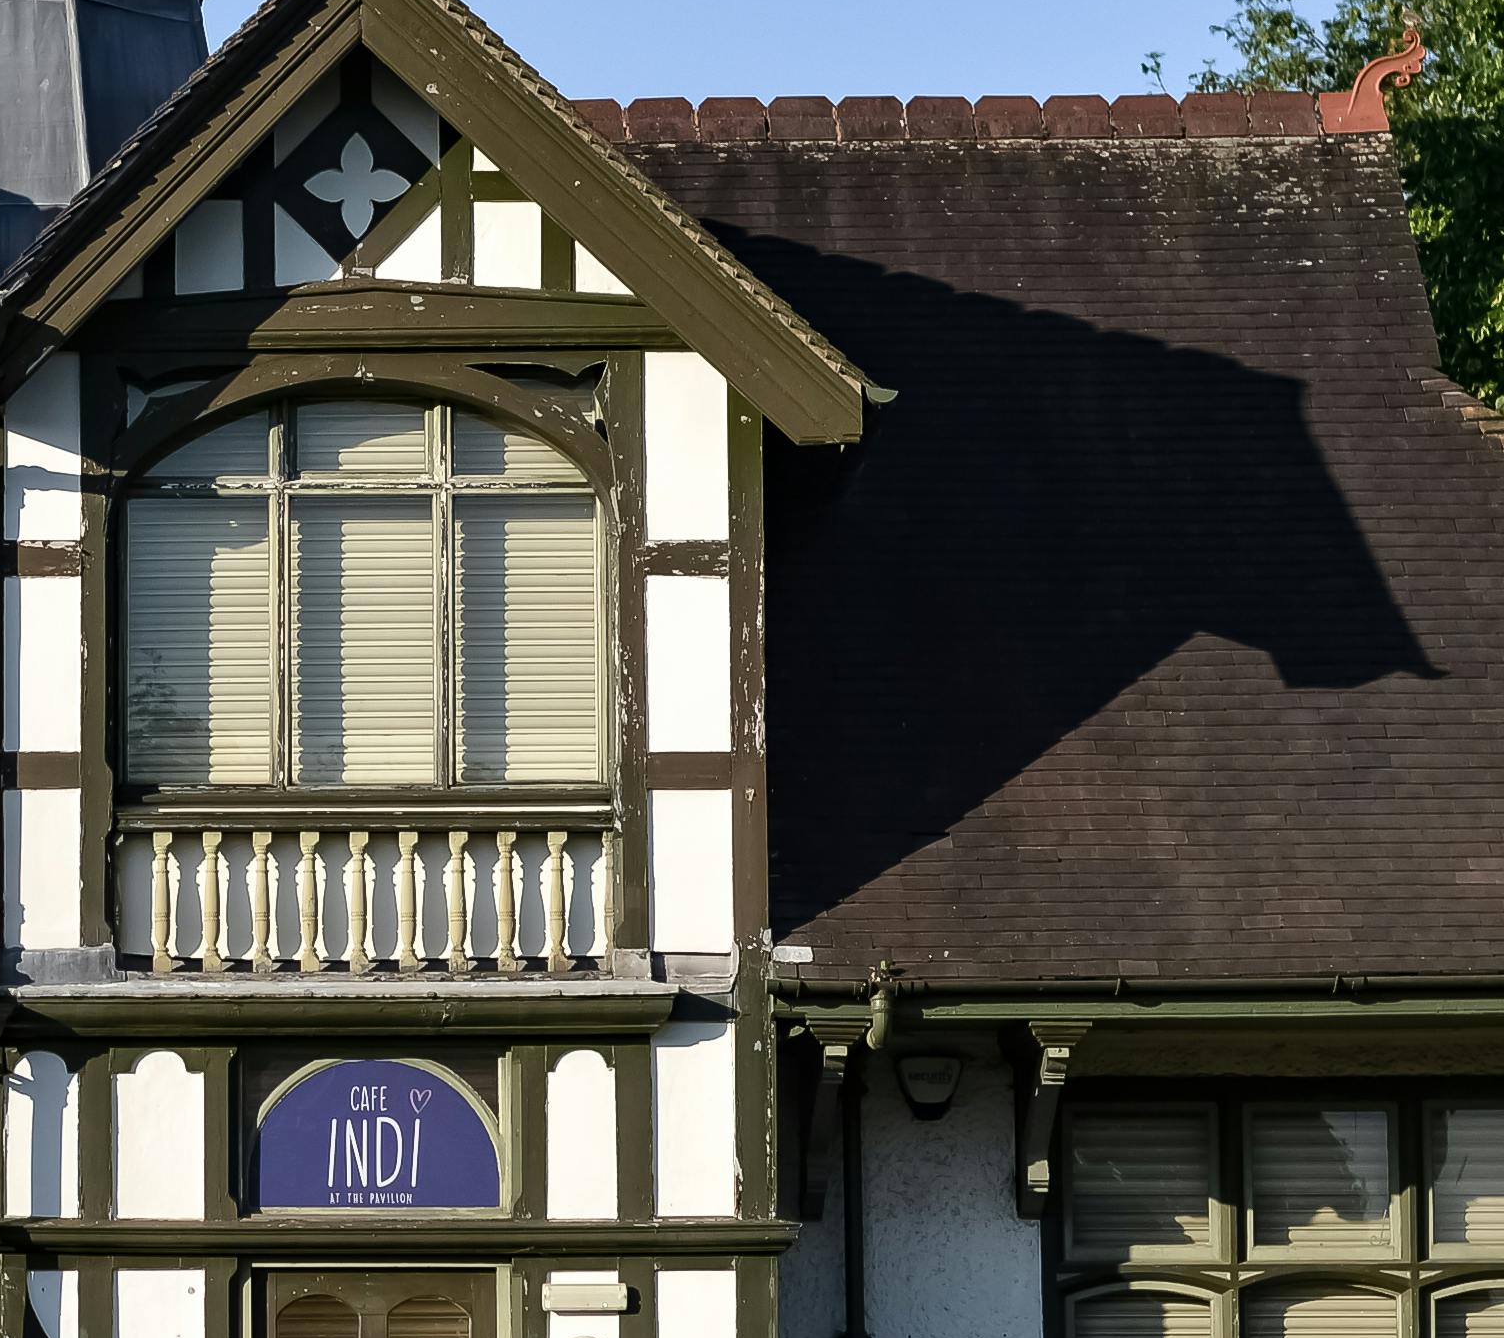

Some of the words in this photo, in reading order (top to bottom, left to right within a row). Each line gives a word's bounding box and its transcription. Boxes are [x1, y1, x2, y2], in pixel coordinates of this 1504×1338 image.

[350, 1085, 388, 1112] CAFE
[327, 1116, 421, 1188] INDI
[330, 1193, 340, 1204] AT
[348, 1193, 364, 1204] THE
[369, 1192, 413, 1205] PAVILION
